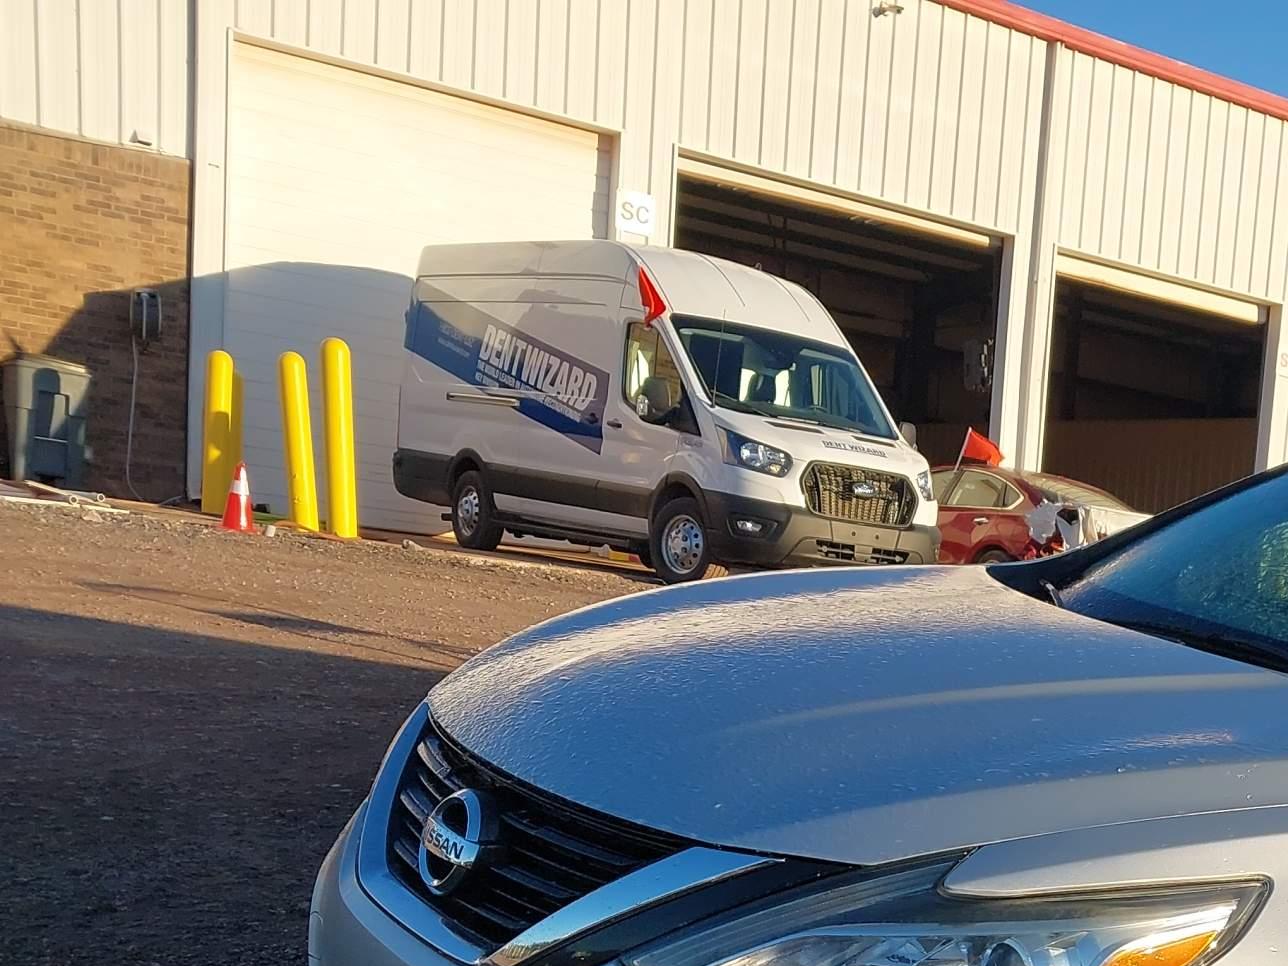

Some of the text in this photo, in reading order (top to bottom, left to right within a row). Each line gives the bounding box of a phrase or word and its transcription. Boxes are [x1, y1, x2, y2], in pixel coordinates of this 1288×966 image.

[621, 201, 649, 224] SC
[479, 324, 526, 378] DENT
[521, 345, 597, 412] WIZARD
[423, 823, 464, 859] ISSAN
